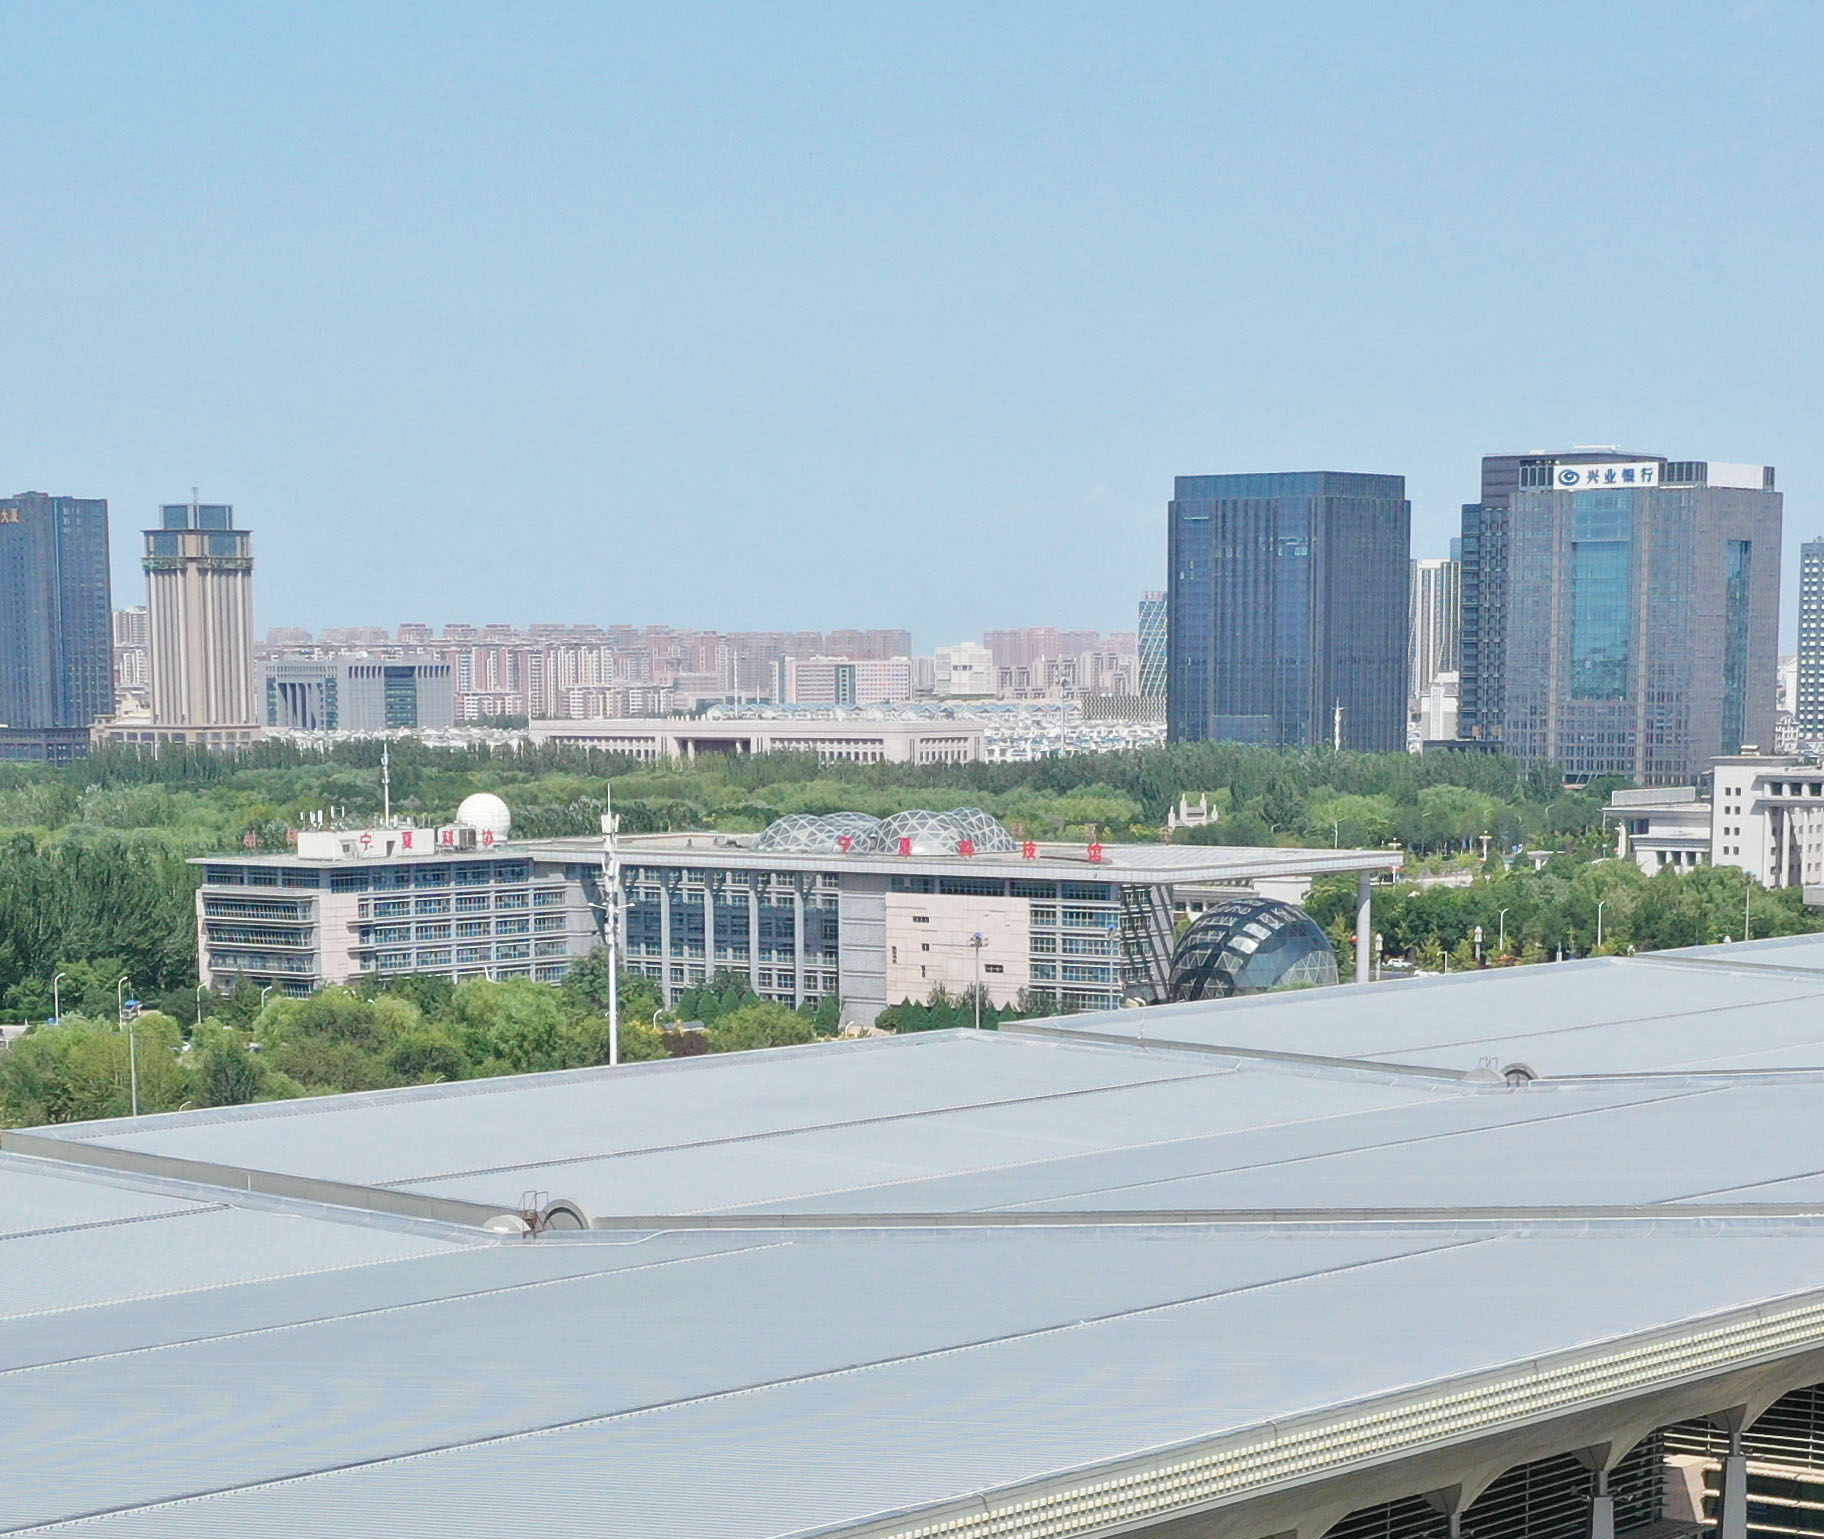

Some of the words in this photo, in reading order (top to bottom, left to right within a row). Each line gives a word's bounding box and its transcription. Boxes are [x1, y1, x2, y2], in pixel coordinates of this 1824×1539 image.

[1587, 467, 1653, 484] 兴业银行
[360, 829, 494, 851] 宁夏科协
[837, 834, 1105, 863] 宁夏科技馆
